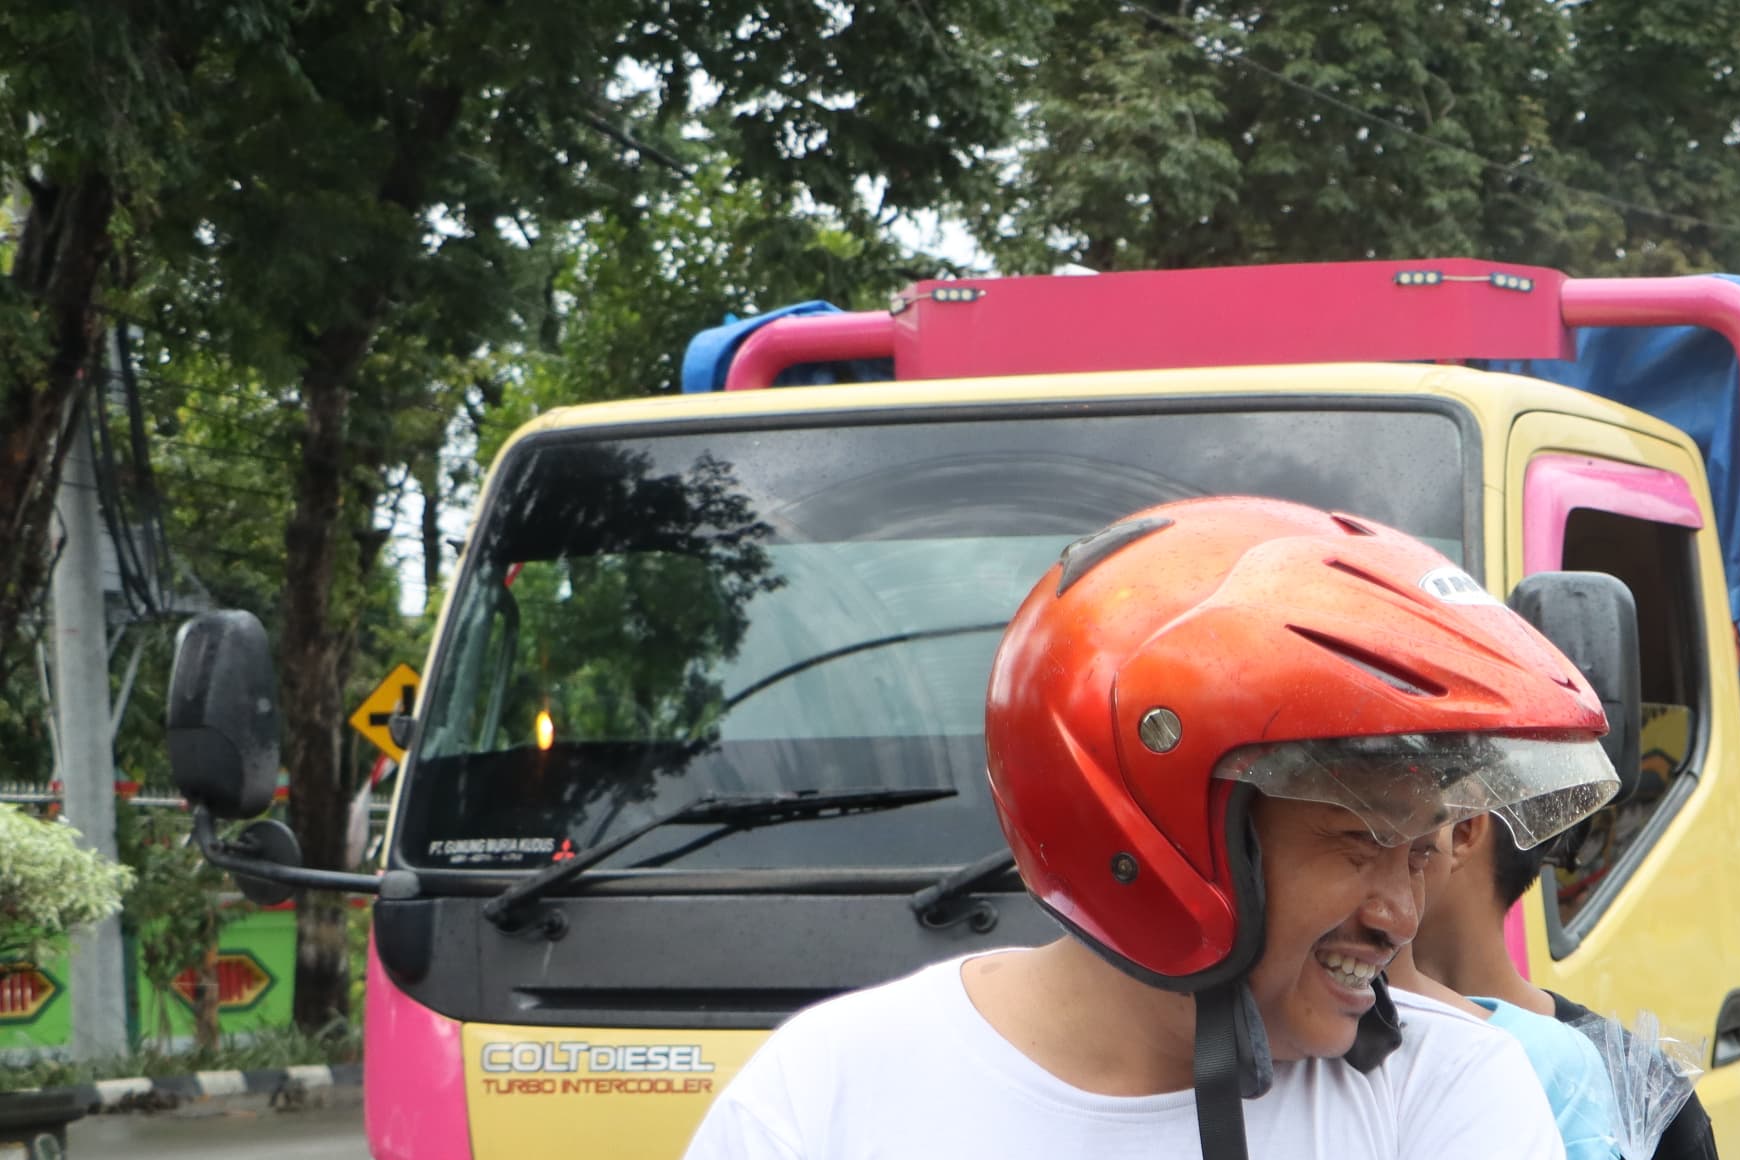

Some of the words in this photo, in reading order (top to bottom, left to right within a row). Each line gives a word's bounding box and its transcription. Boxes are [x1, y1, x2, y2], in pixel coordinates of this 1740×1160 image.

[481, 1041, 588, 1073] COLT
[588, 1044, 716, 1073] DIESEL
[483, 1078, 556, 1095] TURBO
[561, 1078, 714, 1095] INTERCOOLER
